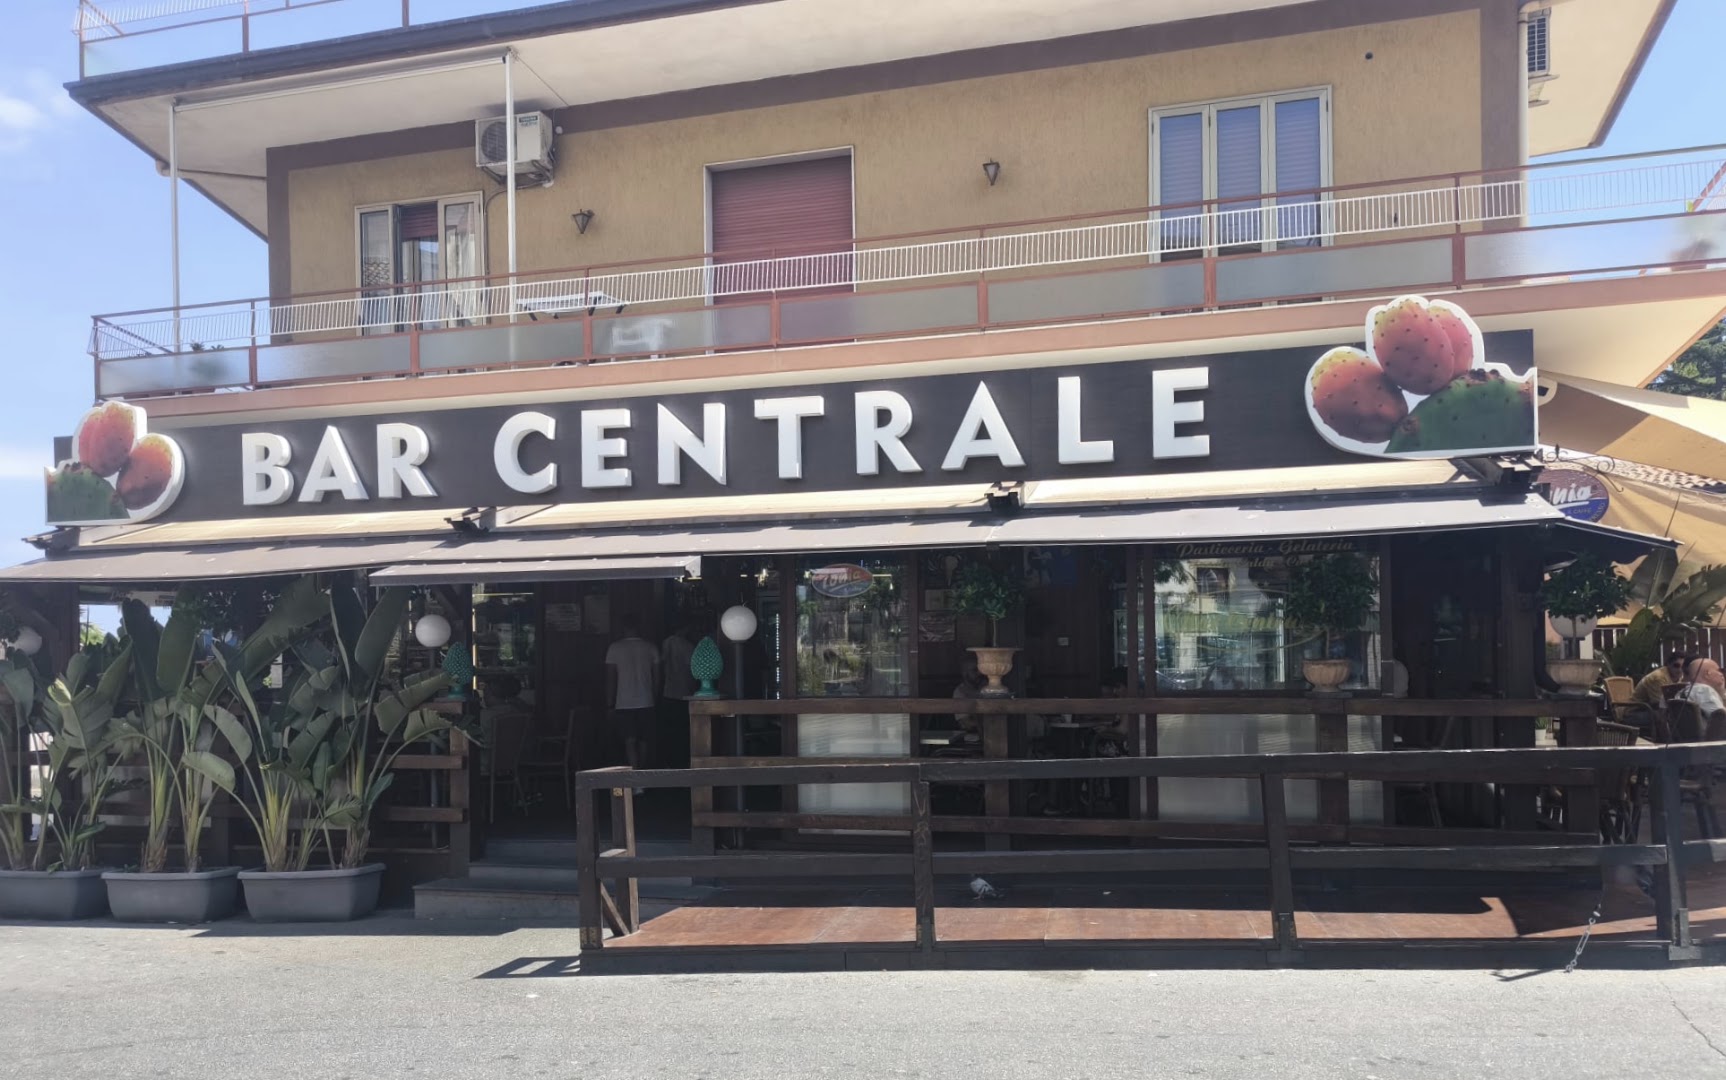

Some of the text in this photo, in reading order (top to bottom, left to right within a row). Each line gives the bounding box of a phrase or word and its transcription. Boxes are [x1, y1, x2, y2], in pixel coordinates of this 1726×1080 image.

[242, 366, 1210, 506] BAR CENTRALE
[1550, 483, 1592, 505] nia
[1176, 542, 1264, 557] Pasticceria
[1279, 539, 1353, 555] Gelateria
